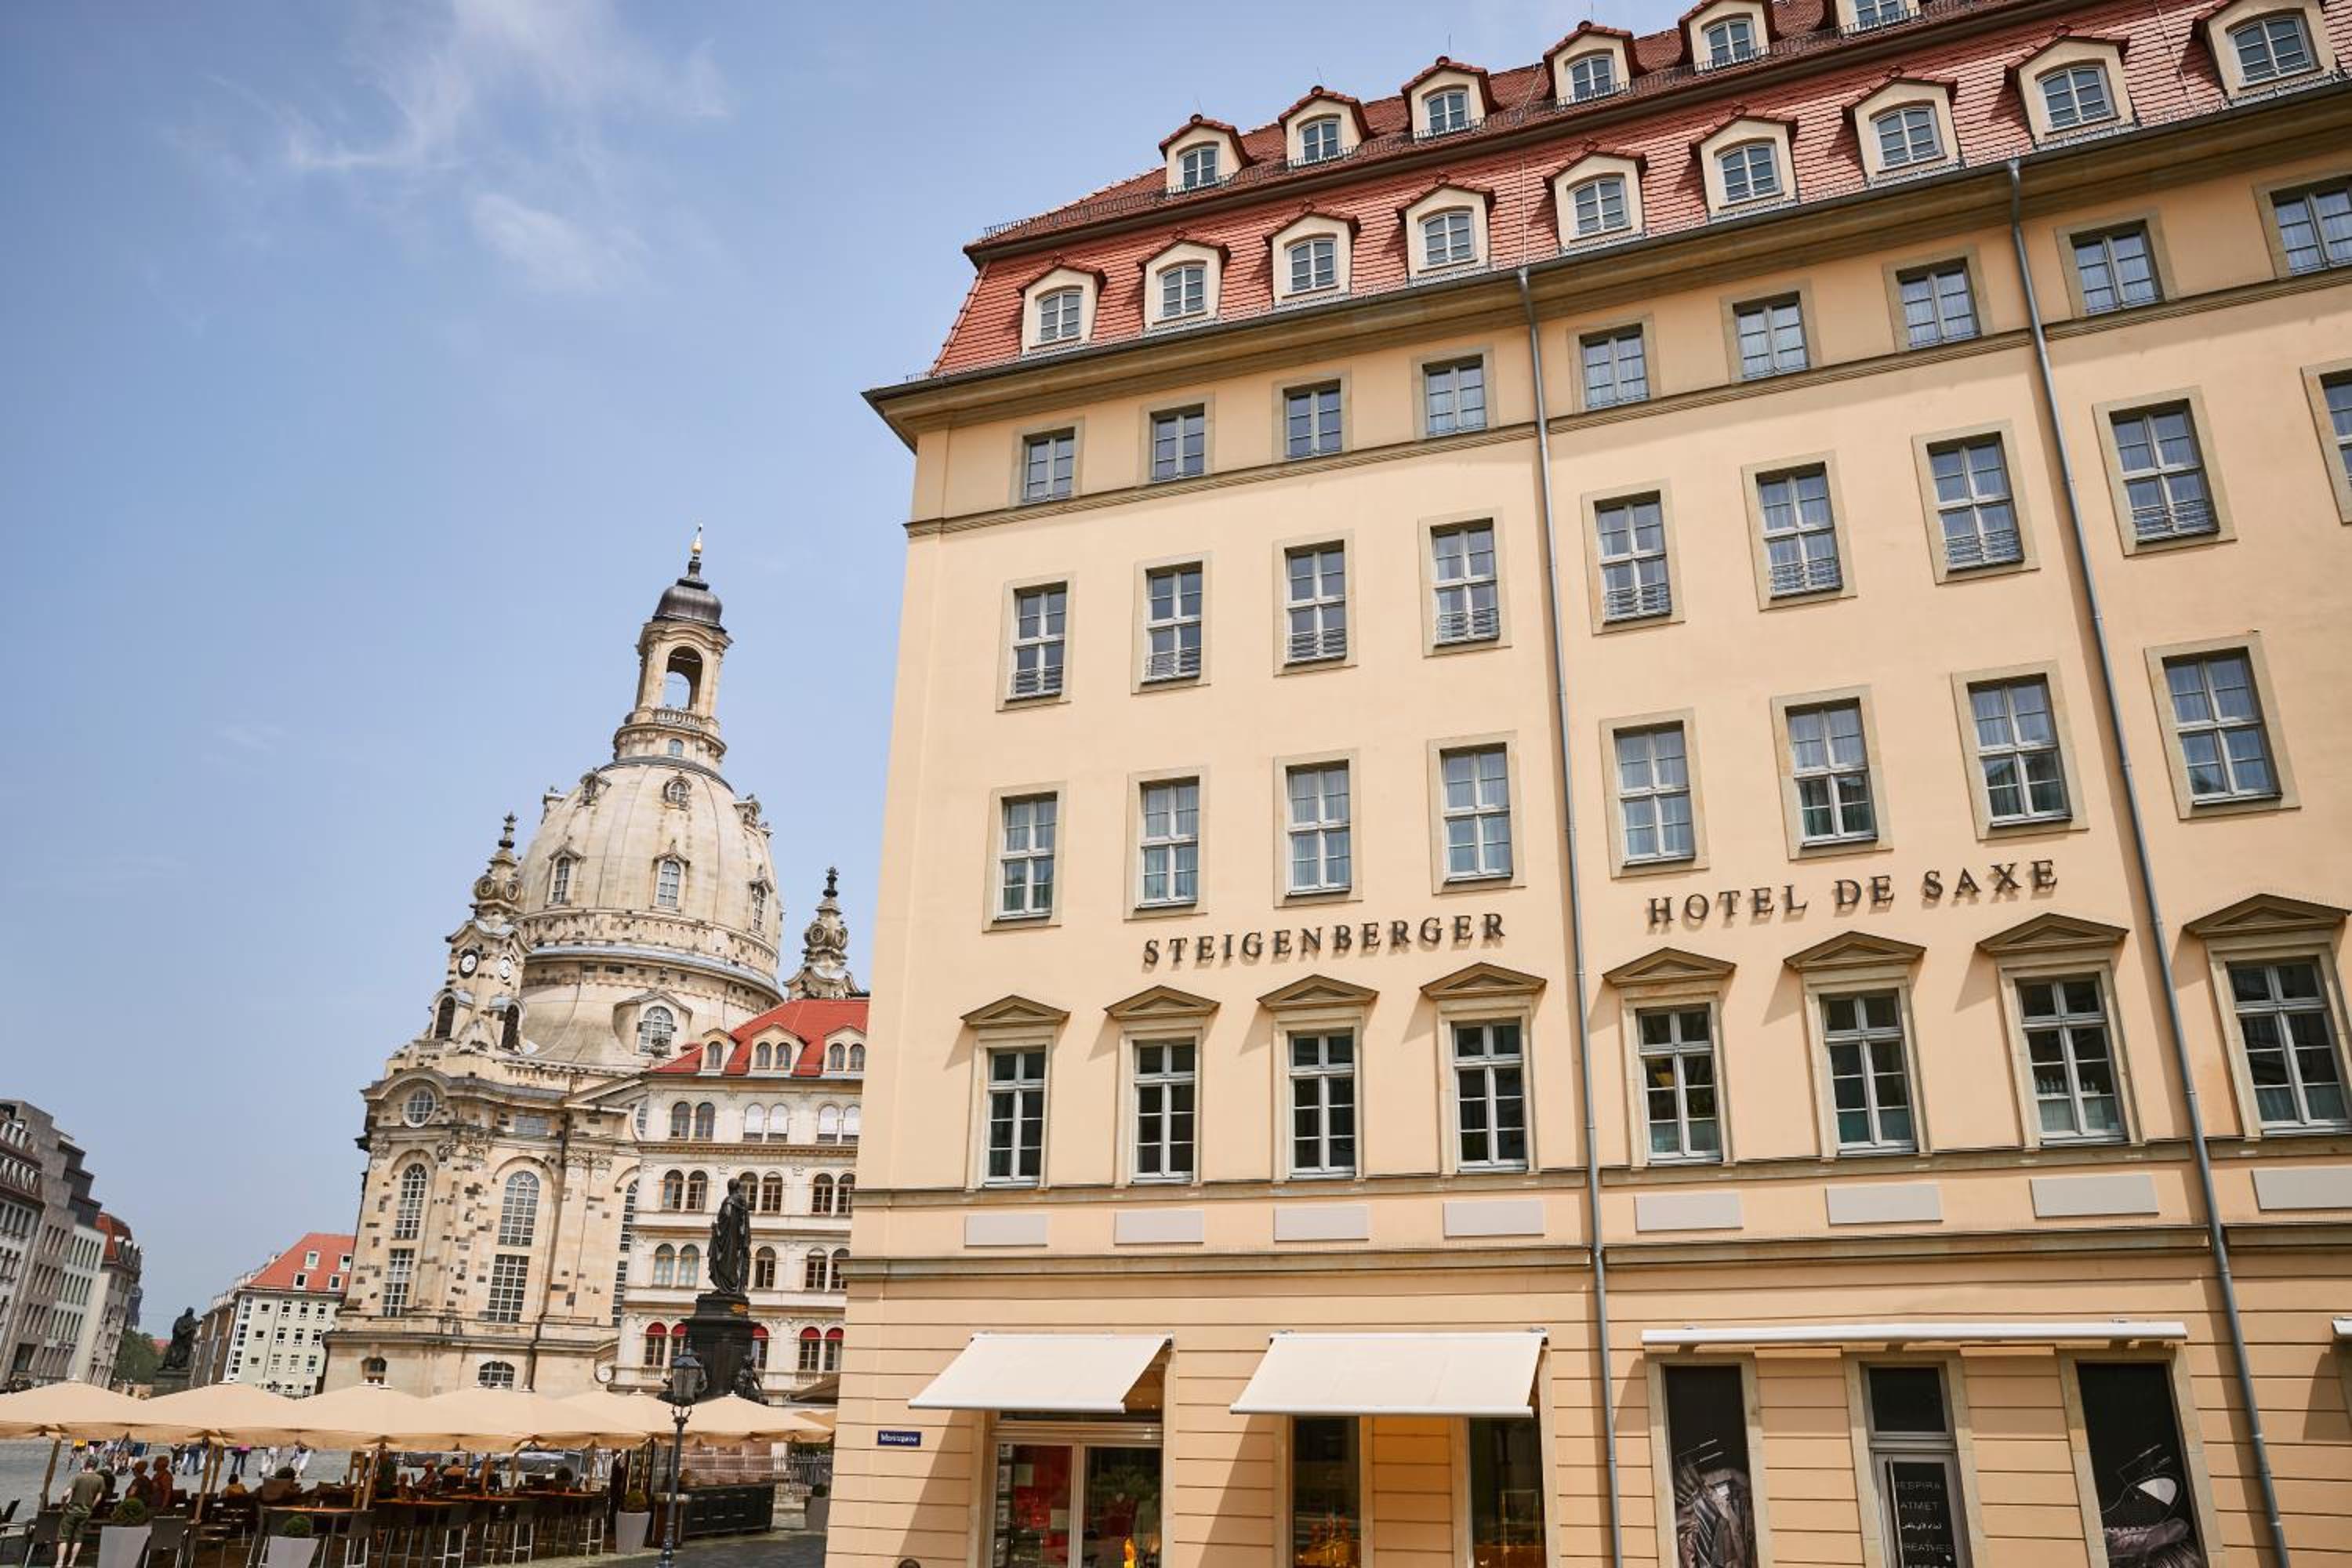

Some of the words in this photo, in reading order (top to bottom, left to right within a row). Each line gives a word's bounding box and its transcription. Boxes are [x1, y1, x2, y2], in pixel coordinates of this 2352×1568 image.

[1648, 884, 1807, 924] HOTEL
[1835, 874, 1895, 906] DE
[1922, 859, 2058, 900] SAXE
[1143, 913, 1505, 965] STEIGENBERGER
